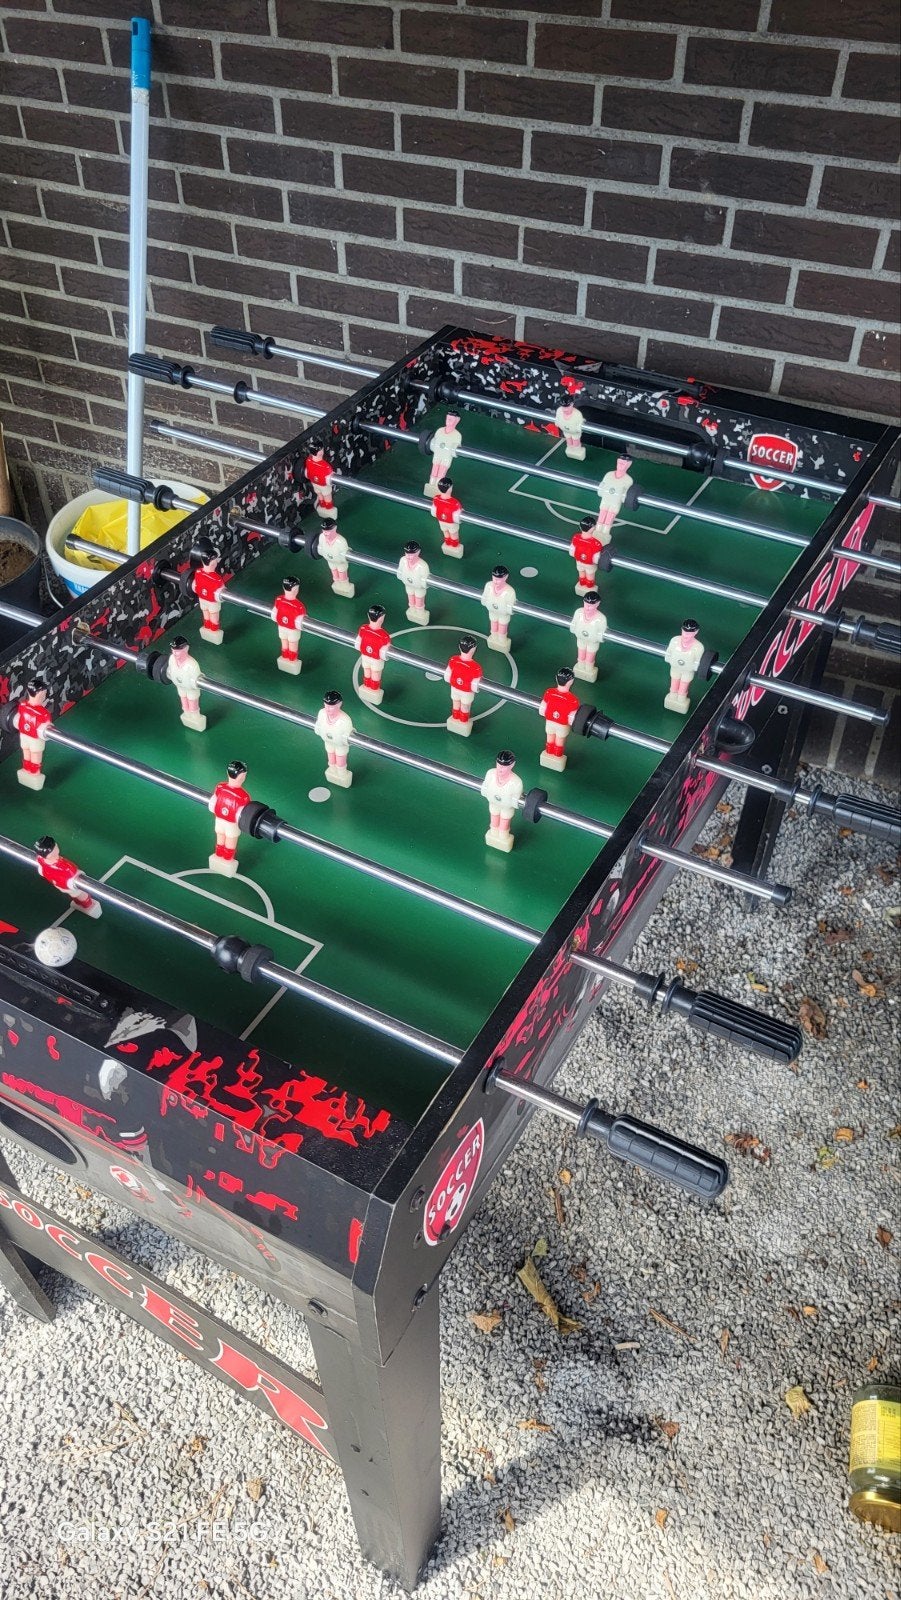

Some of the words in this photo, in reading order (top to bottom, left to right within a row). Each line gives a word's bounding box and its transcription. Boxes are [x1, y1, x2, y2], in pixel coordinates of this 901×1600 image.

[751, 444, 794, 466] SOCCER
[732, 502, 876, 721] OCCER
[428, 1134, 480, 1226] SOCCER
